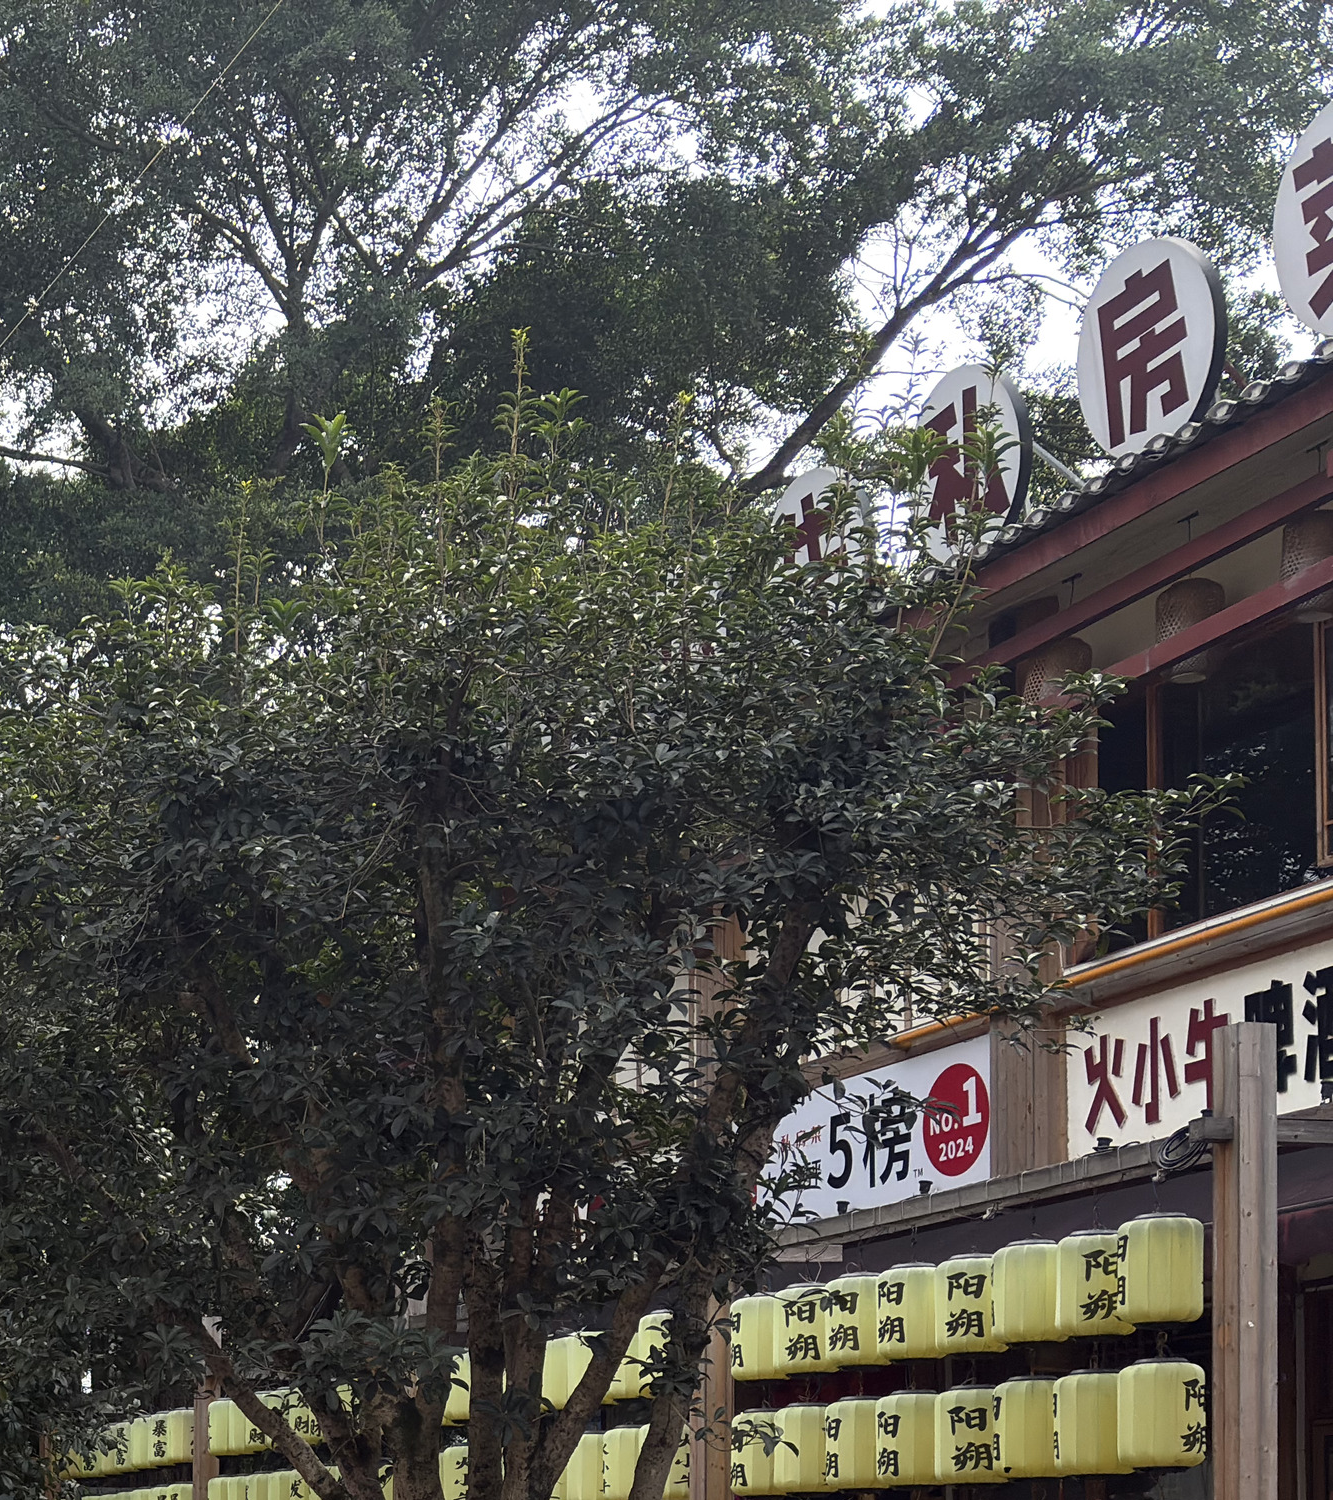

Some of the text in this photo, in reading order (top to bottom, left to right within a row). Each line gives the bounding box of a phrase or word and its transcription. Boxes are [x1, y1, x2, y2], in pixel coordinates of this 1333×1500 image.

[938, 1136, 974, 1162] 2024
[783, 1299, 822, 1362] 阳朔
[878, 1280, 906, 1344] 阳朔
[946, 1272, 985, 1339] 阳朔
[152, 1419, 167, 1459] 暴富
[947, 1406, 994, 1472] 阳朔
